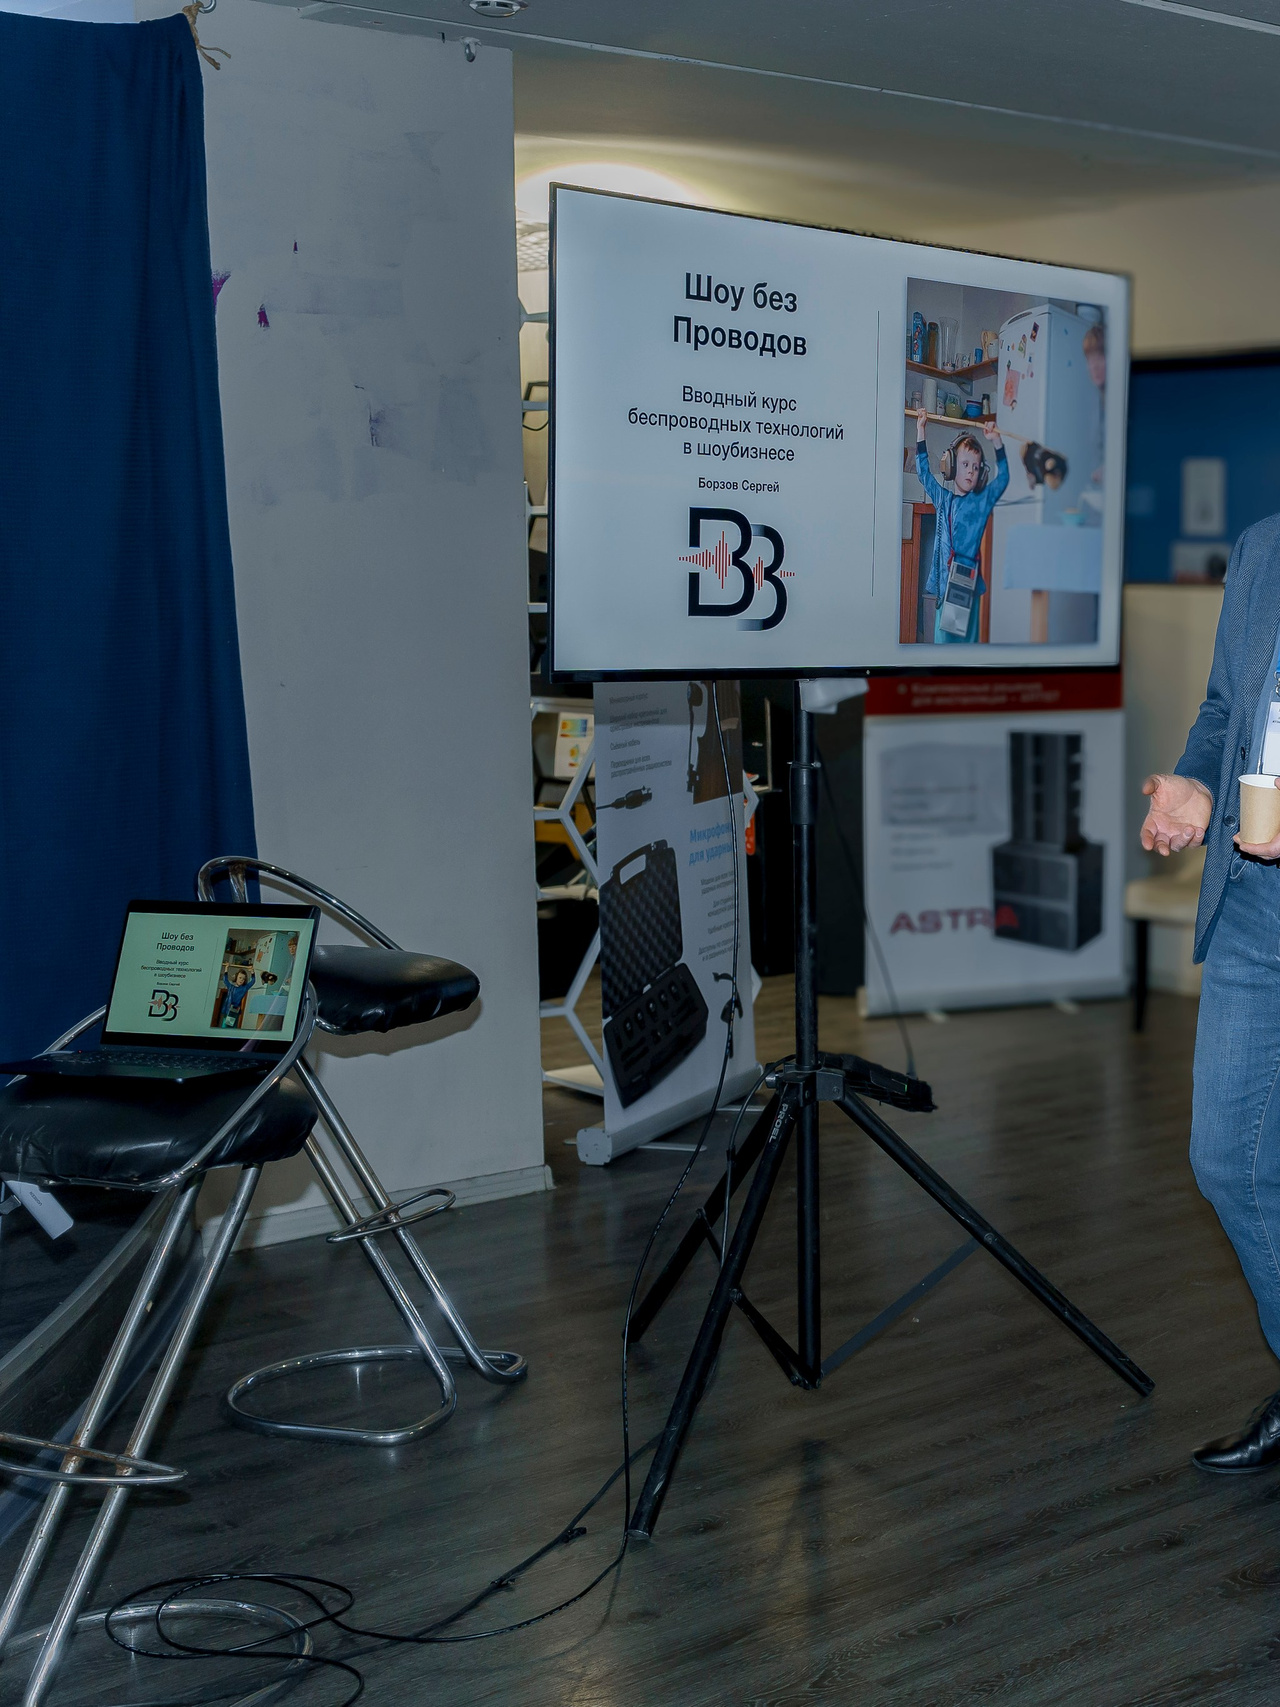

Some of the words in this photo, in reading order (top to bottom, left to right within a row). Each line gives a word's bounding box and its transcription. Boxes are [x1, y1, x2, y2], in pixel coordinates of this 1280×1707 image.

[685, 271, 745, 312] Шоу
[753, 282, 798, 313] без
[673, 315, 807, 358] Проводов
[682, 385, 757, 409] Вводный
[762, 396, 797, 414] курс
[628, 407, 751, 433] беспроводных
[756, 421, 844, 440] технологий
[683, 442, 692, 454] в
[697, 441, 795, 461] шоубизнесе
[698, 477, 738, 491] Борзов
[741, 479, 780, 493] Сергей
[690, 822, 733, 843] Микрофон
[689, 850, 704, 866] для
[706, 842, 734, 863] ударны
[890, 904, 1019, 935] ASTRA
[156, 943, 195, 952] Проводов
[162, 932, 178, 941] Шоу
[180, 933, 194, 941] без
[769, 1103, 789, 1143] PROEL
